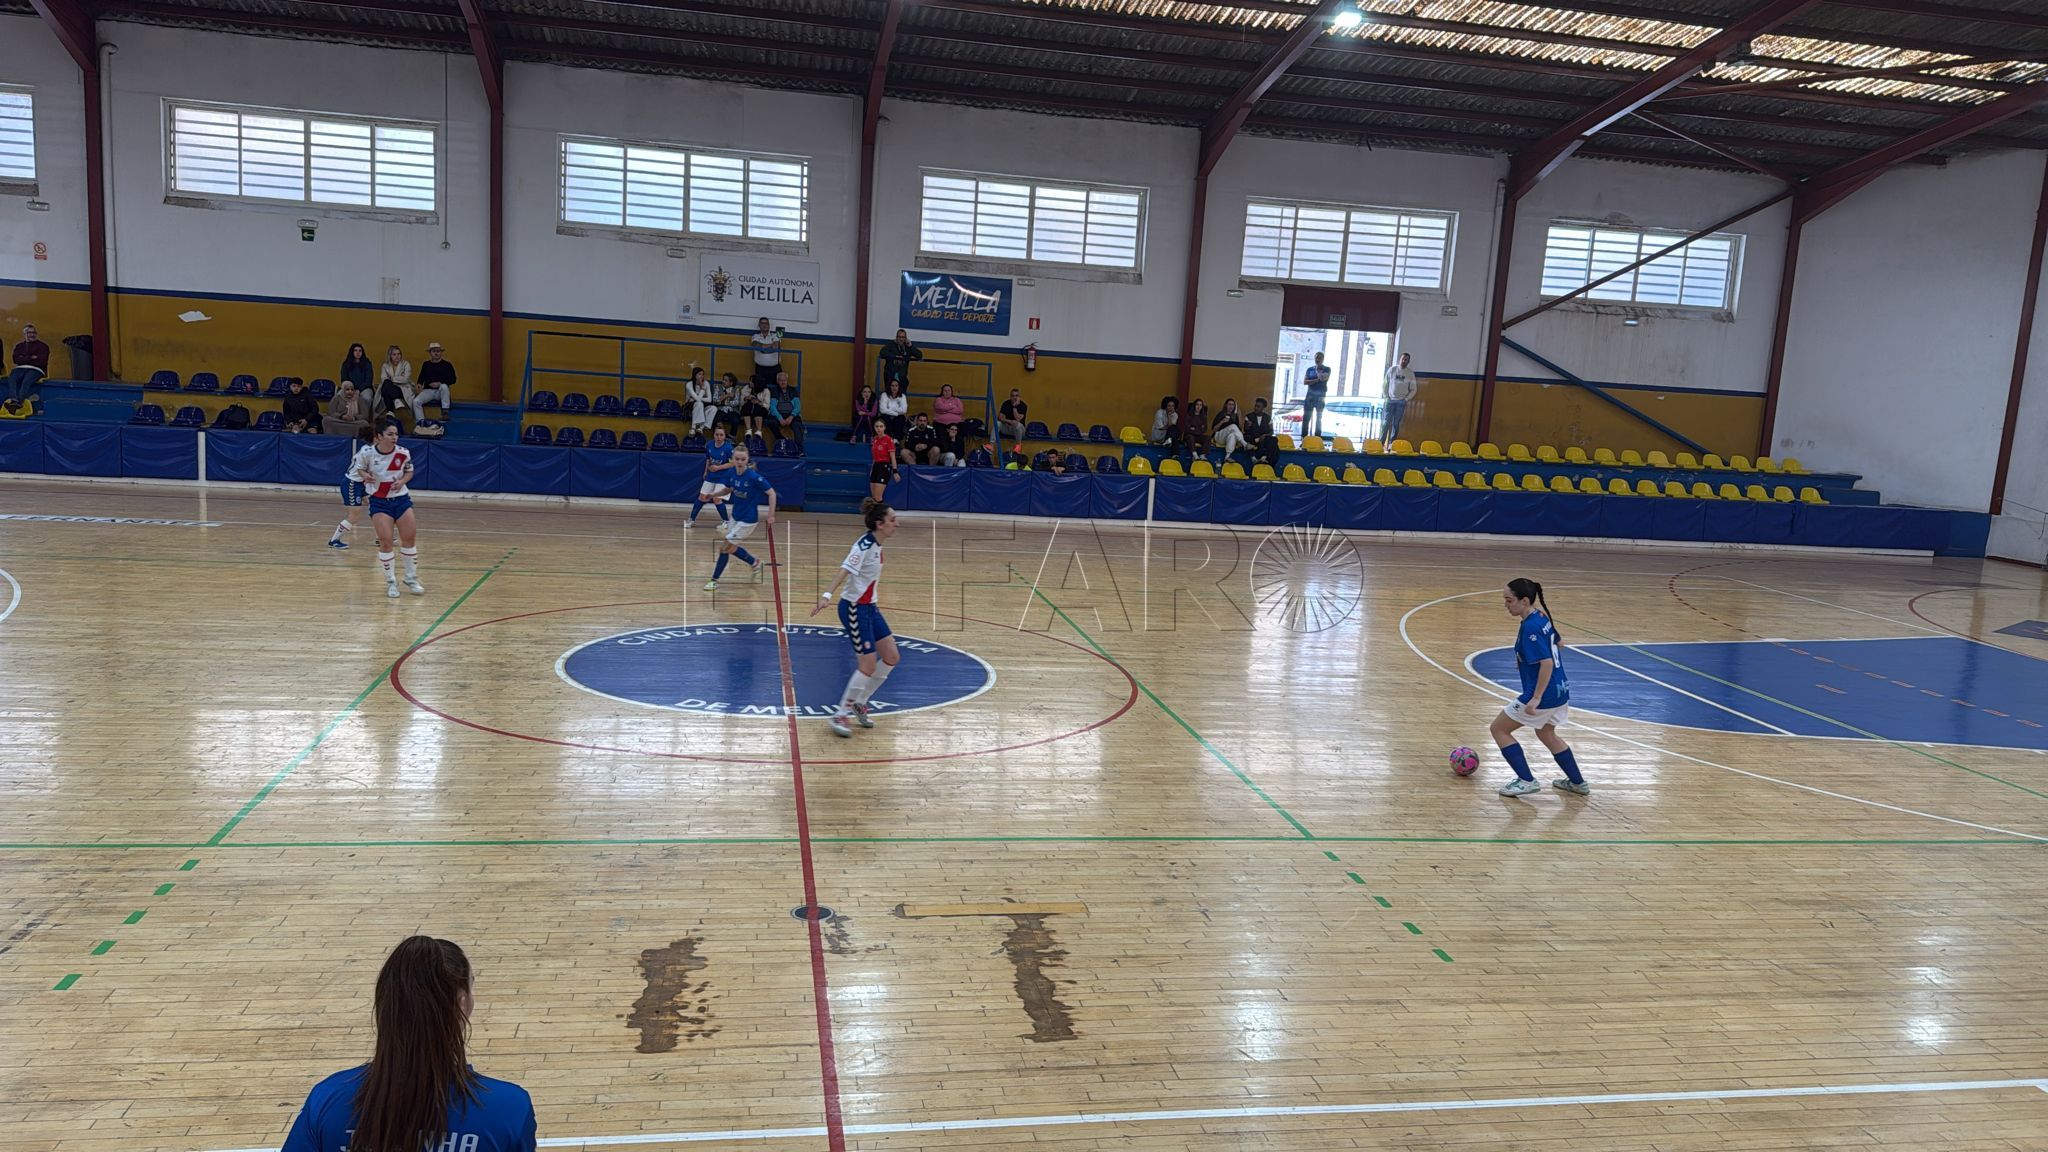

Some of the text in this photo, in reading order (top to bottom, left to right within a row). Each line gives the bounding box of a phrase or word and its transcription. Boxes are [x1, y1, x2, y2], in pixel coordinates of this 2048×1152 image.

[738, 275, 814, 288] CIUDAD AUTÓNOMA
[740, 284, 814, 304] MELILLA
[911, 285, 1001, 313] MELILLA
[912, 309, 996, 323] CIUDAD DEL DEPORTE
[617, 626, 939, 653] CIUDAD AUTÓMA
[675, 698, 899, 715] DE MELIA
